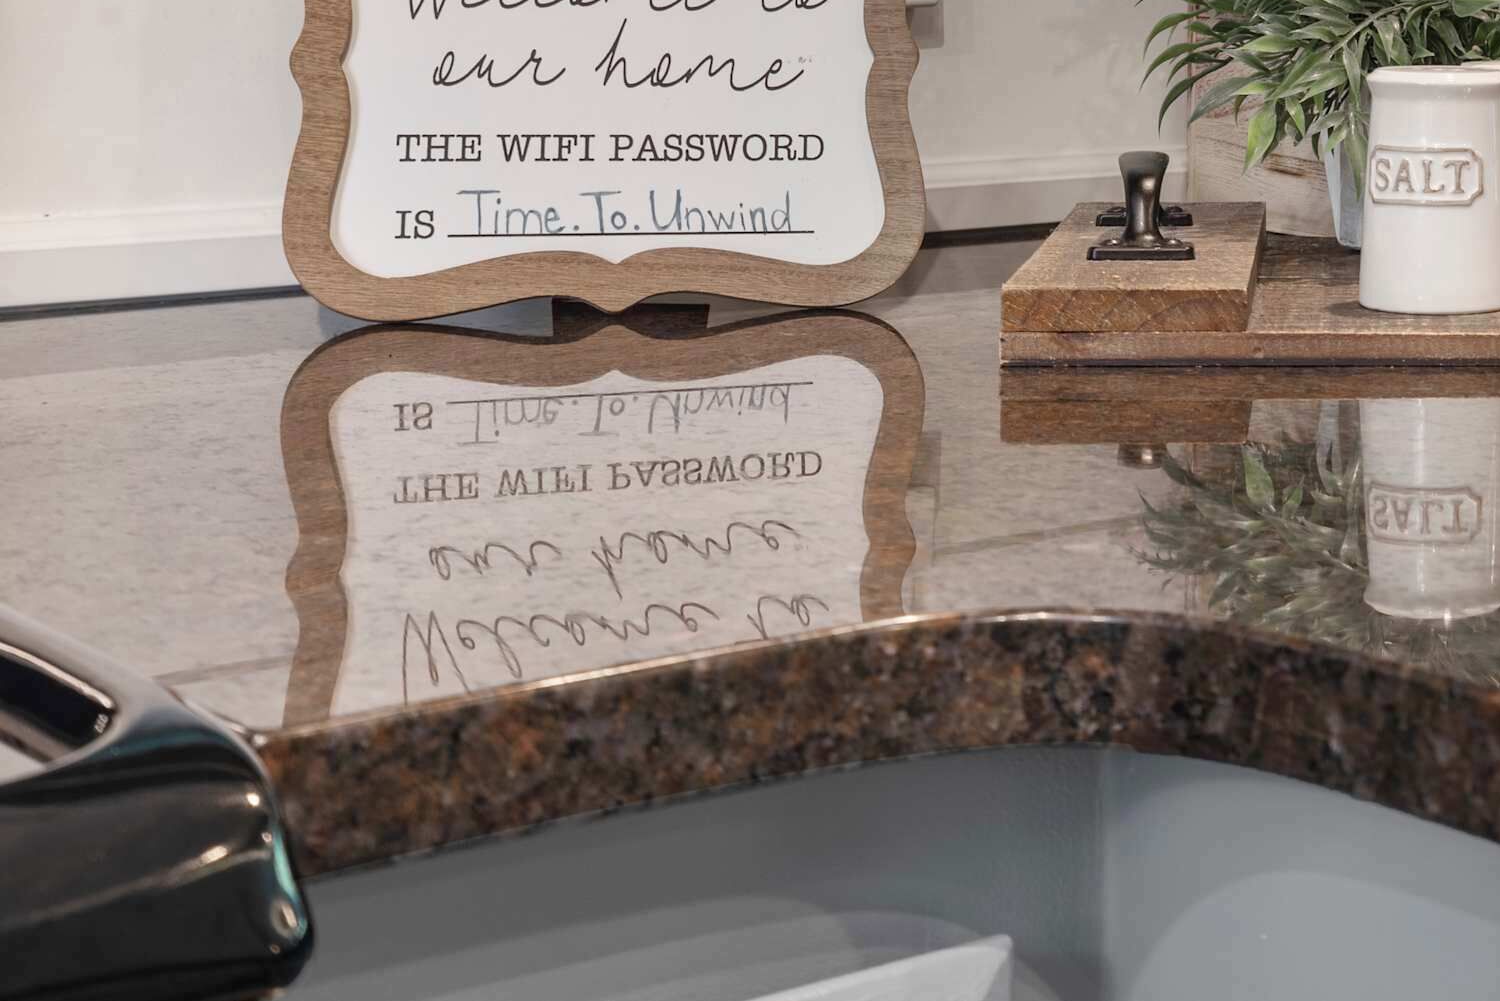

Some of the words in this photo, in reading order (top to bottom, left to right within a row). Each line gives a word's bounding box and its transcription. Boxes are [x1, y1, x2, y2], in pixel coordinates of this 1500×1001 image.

[433, 49, 566, 87] our
[595, 18, 804, 91] home
[397, 134, 481, 162] THE
[497, 134, 596, 162] WIFI
[609, 134, 825, 162] PASSWORD
[1375, 158, 1471, 194] SALT
[395, 210, 435, 239] IS
